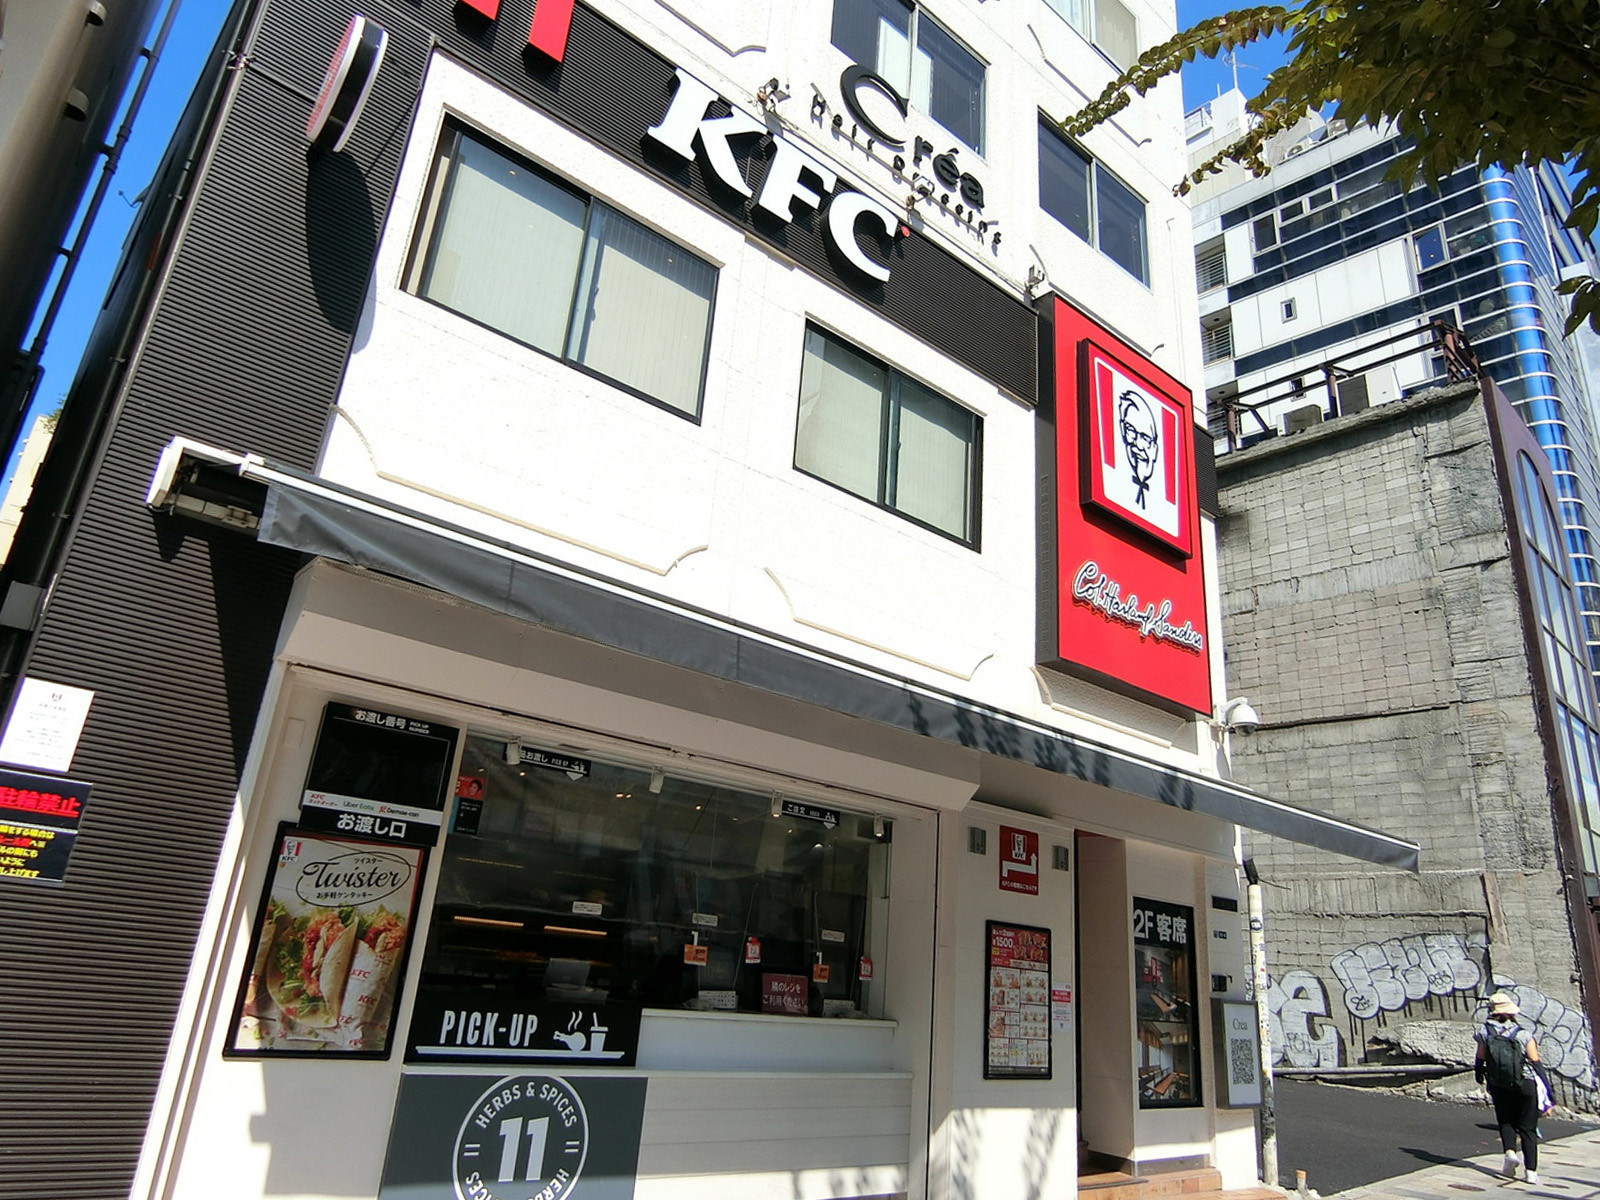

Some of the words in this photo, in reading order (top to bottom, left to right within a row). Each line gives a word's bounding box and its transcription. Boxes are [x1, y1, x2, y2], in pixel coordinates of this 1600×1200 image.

[840, 64, 985, 209] Créa
[647, 67, 900, 283] KFC
[893, 154, 1002, 245] Drssing
[1103, 581, 1155, 636] Harland
[1153, 599, 1203, 650] Sanders
[355, 710, 406, 729] お渡し番号
[360, 803, 374, 811] Eats
[337, 813, 407, 838] お渡し口
[303, 861, 401, 888] Twister
[316, 891, 373, 899] お手軽ケンタッキー
[1133, 908, 1153, 939] 2F
[1156, 913, 1187, 944] 客席
[351, 969, 371, 979] KFC
[439, 1010, 538, 1047] PICK-UP
[475, 1084, 521, 1129] HERBS
[526, 1081, 535, 1097] &
[540, 1083, 578, 1128] SPICES
[498, 1116, 549, 1182] 11
